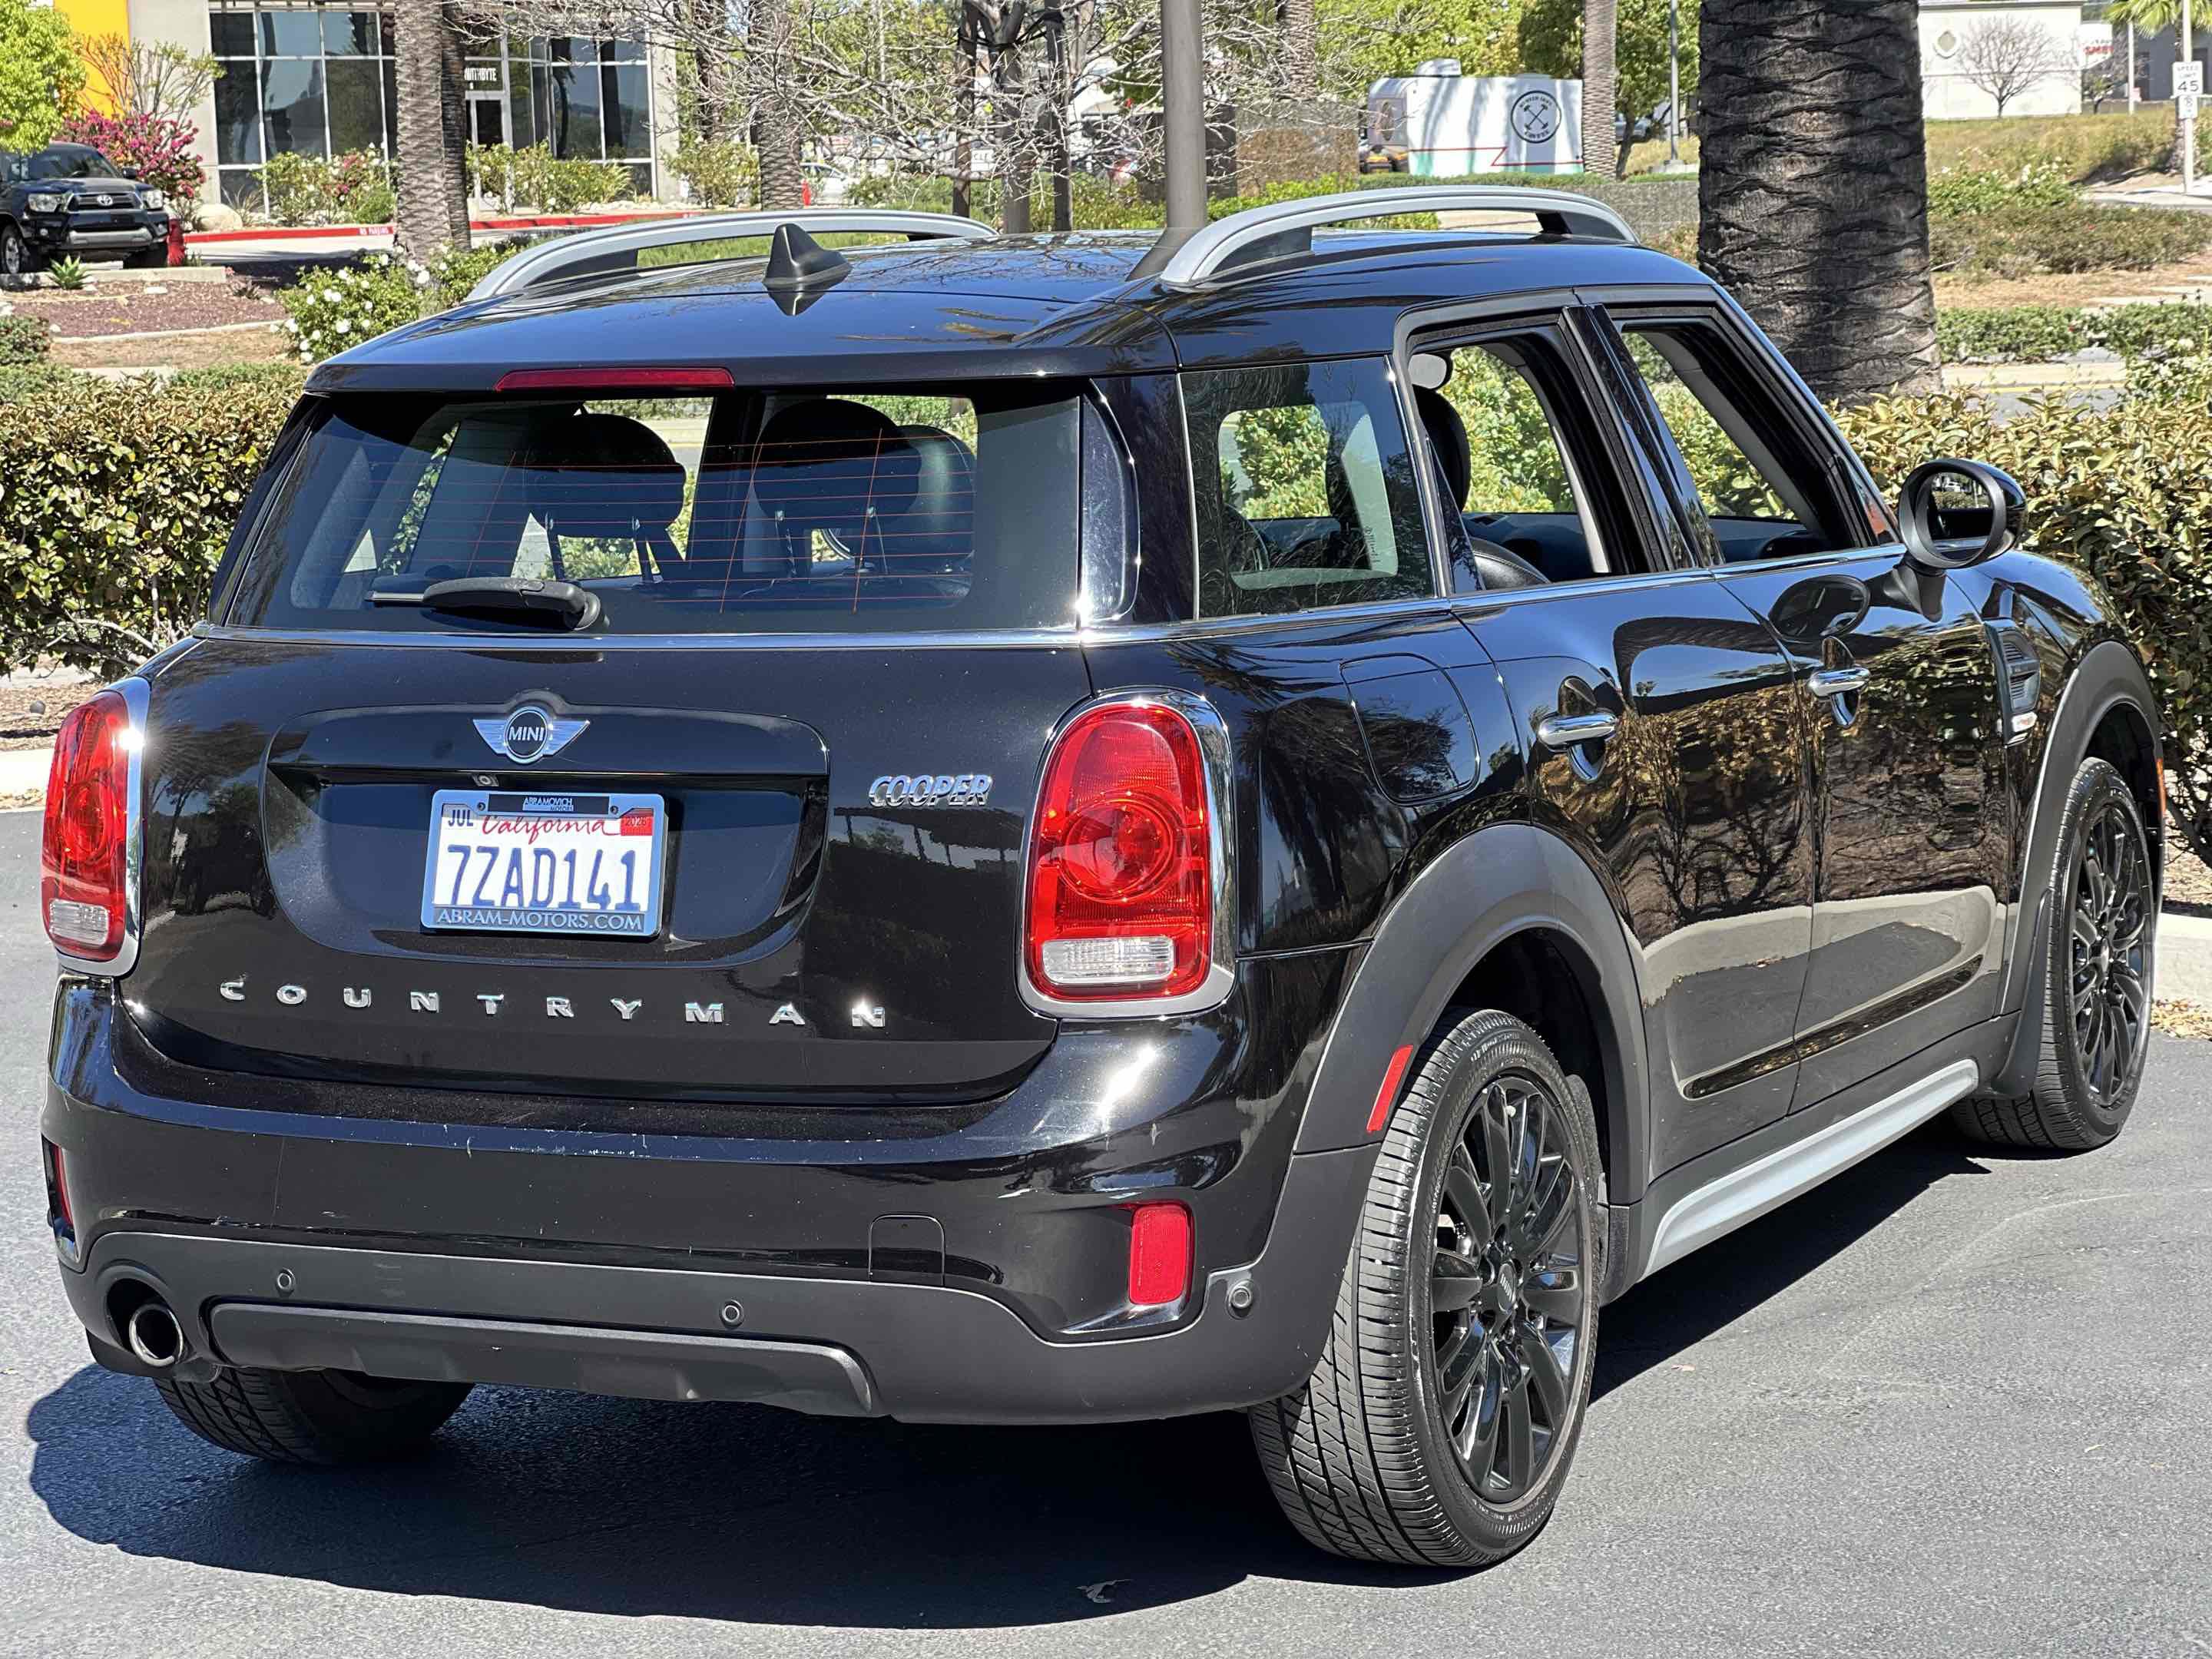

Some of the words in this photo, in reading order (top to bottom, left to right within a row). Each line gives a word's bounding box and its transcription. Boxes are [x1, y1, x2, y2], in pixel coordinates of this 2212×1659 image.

[2177, 80, 2200, 92] 45
[508, 726, 545, 741] MINI
[522, 796, 573, 806] ABRAMOVICH
[868, 774, 992, 806] COOPER
[448, 810, 474, 827] JUL
[482, 814, 619, 845] California
[447, 844, 641, 912] 7ZAD141
[435, 907, 644, 932] ABRAM-MOTORS.COM
[220, 980, 886, 1027] COUNTRYMAN
